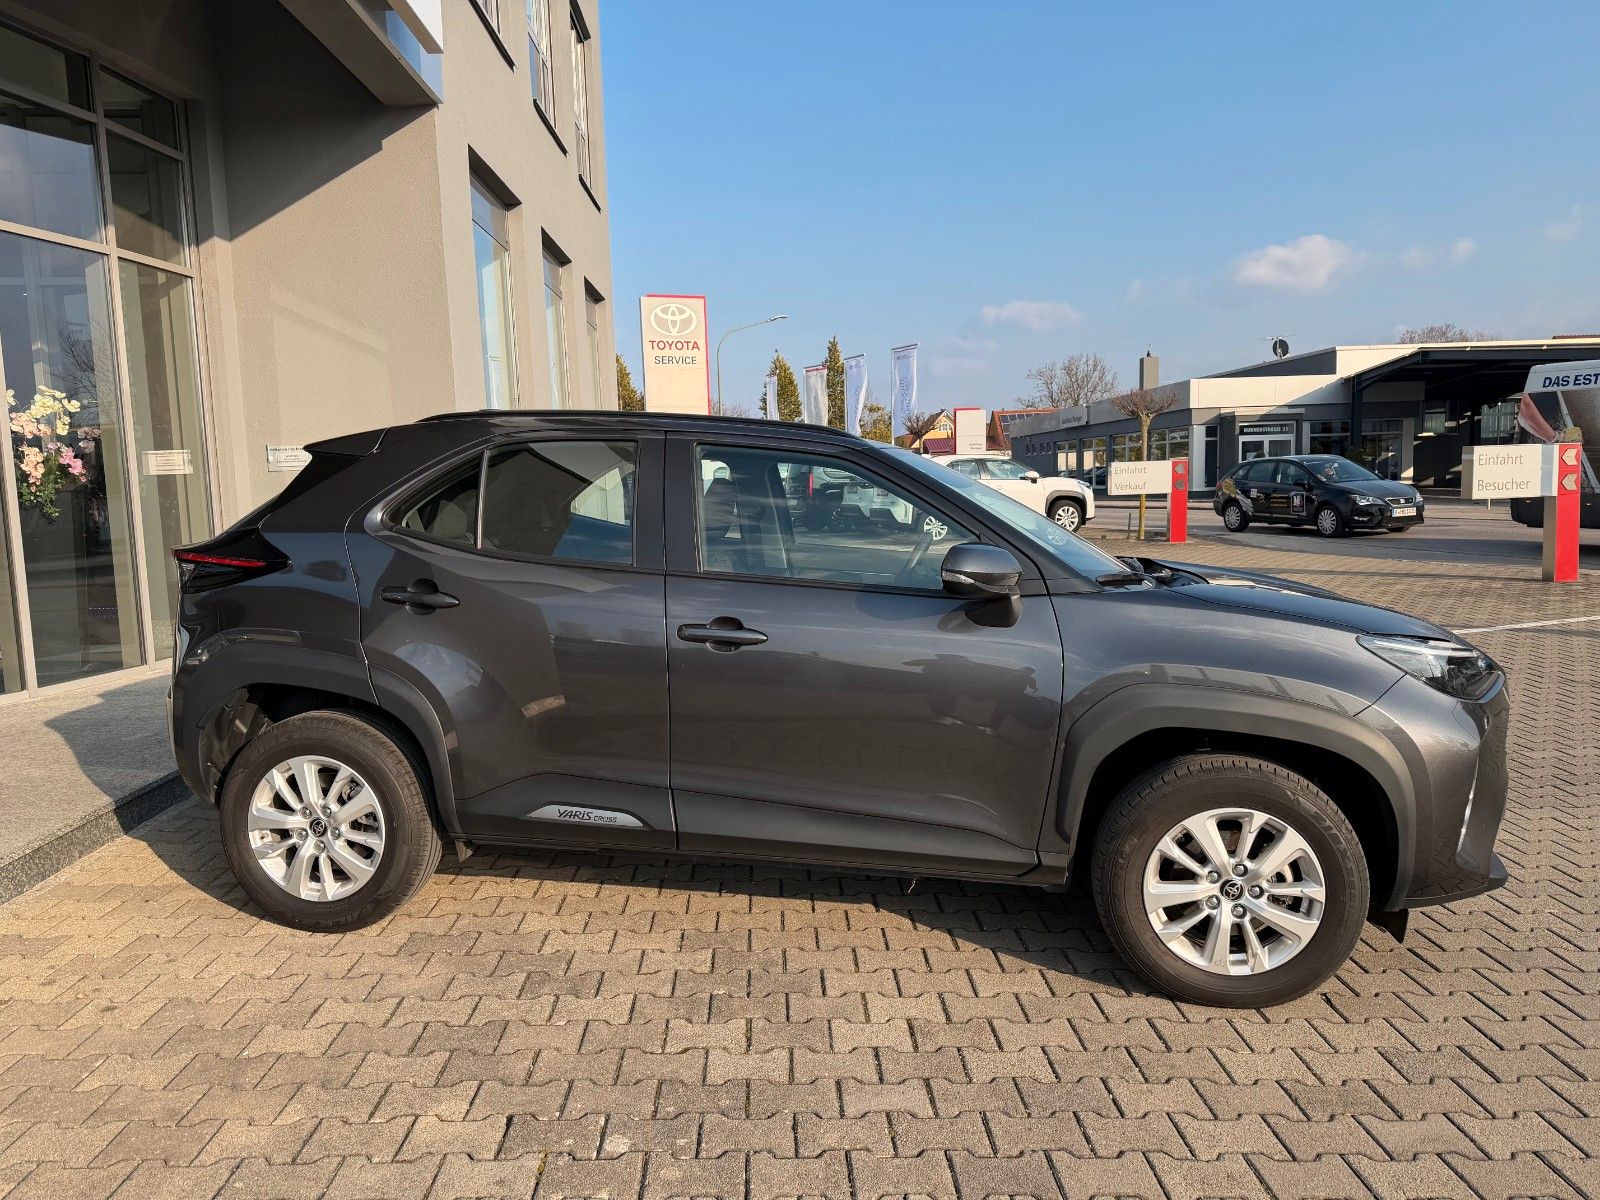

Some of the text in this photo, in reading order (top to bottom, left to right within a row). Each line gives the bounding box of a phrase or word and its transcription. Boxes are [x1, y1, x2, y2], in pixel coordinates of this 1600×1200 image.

[648, 340, 701, 351] TOYOTA
[654, 355, 697, 365] SERVICE
[1542, 375, 1571, 388] DAS
[1478, 453, 1524, 466] Einfahrt
[1114, 466, 1147, 475] Einfahrt
[1114, 482, 1147, 491] Verkauf
[1477, 478, 1531, 492] Besucher
[557, 808, 618, 823] YARIS CROSS
